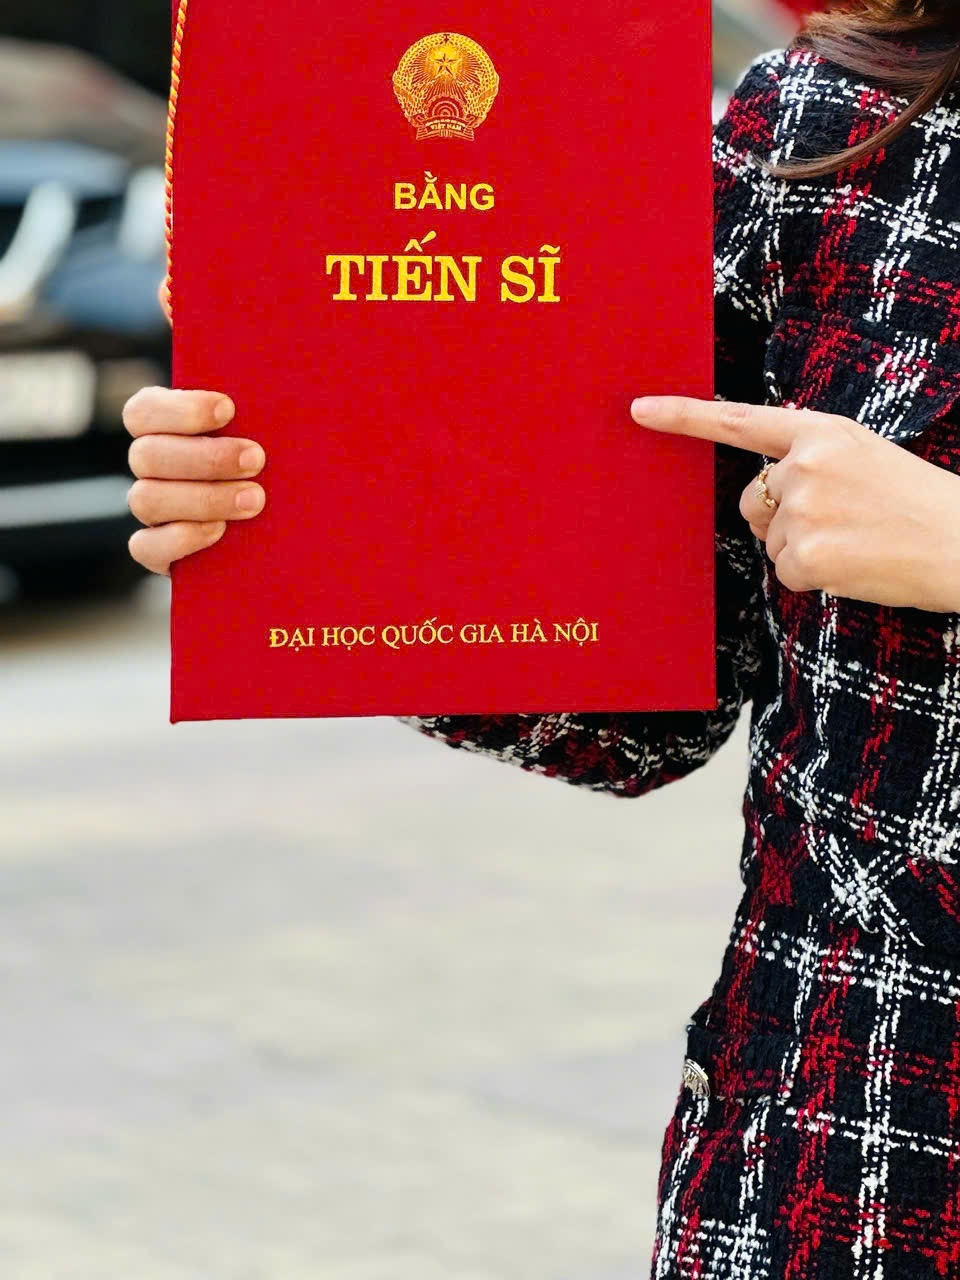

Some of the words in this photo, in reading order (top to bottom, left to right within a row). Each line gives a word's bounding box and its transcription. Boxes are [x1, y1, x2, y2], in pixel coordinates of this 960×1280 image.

[394, 170, 494, 210] BẰNG
[325, 230, 482, 301] TIẾN
[500, 243, 560, 303] SĨ
[269, 627, 315, 651] ĐẠI
[321, 625, 375, 650] HỌC
[381, 616, 453, 649] QUỐC
[459, 623, 504, 643] GIA
[510, 617, 548, 642] HÀ
[552, 616, 599, 646] NỘI
